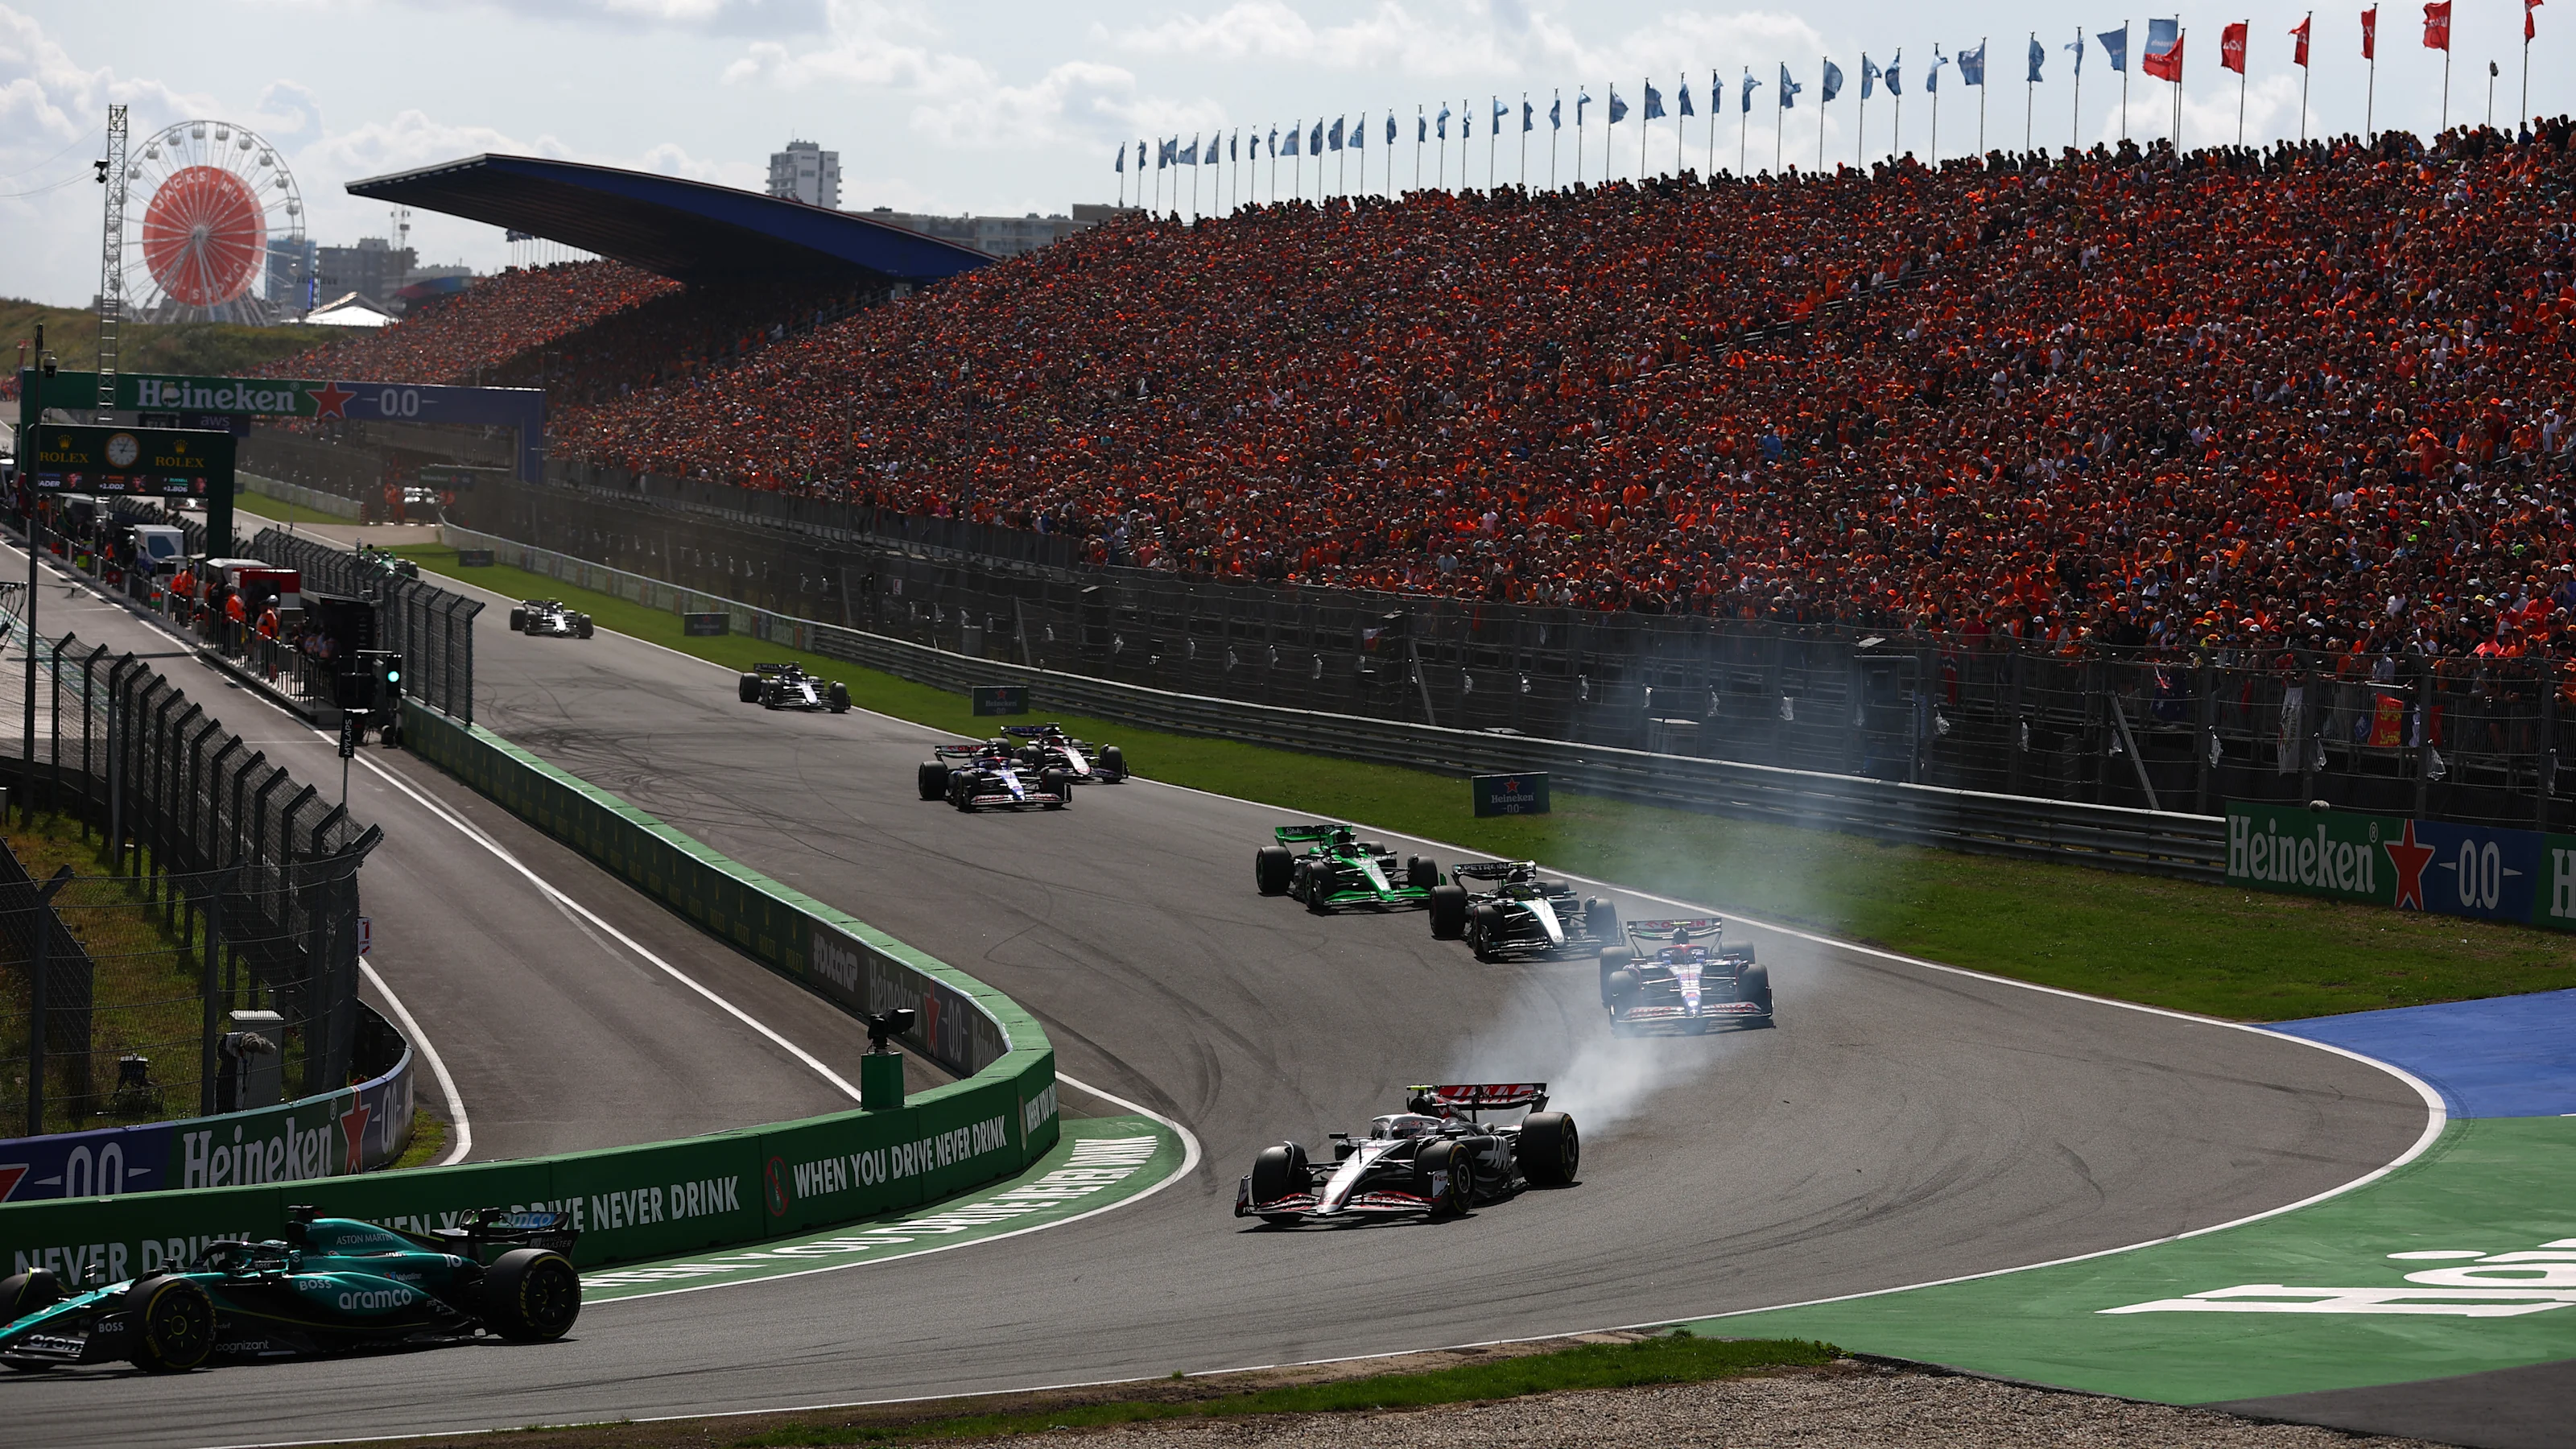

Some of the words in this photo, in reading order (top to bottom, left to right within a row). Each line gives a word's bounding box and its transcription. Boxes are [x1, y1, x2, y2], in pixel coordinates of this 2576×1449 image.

[137, 379, 296, 412] Heineken
[380, 388, 419, 417] 0.0
[200, 415, 230, 427] aws
[39, 452, 89, 464] ROLEX
[155, 456, 205, 468] ROLEX
[39, 480, 61, 488] ADER
[345, 719, 353, 756] MYLAPS
[1491, 793, 1534, 804] Heineken
[2227, 814, 2376, 894] Heineken
[1463, 864, 1509, 872] PETRON
[2458, 838, 2500, 910] 0.0
[183, 1116, 333, 1190] Heineken
[793, 1156, 848, 1199] WHEN
[849, 1149, 886, 1187] YOU
[890, 1137, 934, 1180] DRIVE
[935, 1126, 971, 1168] NEVER
[972, 1115, 1007, 1157] DRINK
[592, 1187, 664, 1232] NEVER
[670, 1175, 740, 1220] DRINK
[336, 1234, 364, 1245] ASTON
[365, 1232, 394, 1243] MARTIN
[14, 1242, 130, 1286] NEVER
[299, 1279, 332, 1291] BOSS
[396, 1272, 423, 1282] Valvoline
[580, 1264, 768, 1291] HEN
[338, 1288, 413, 1310] aramco
[98, 1321, 125, 1333] BOSS
[215, 1340, 270, 1354] cognizant
